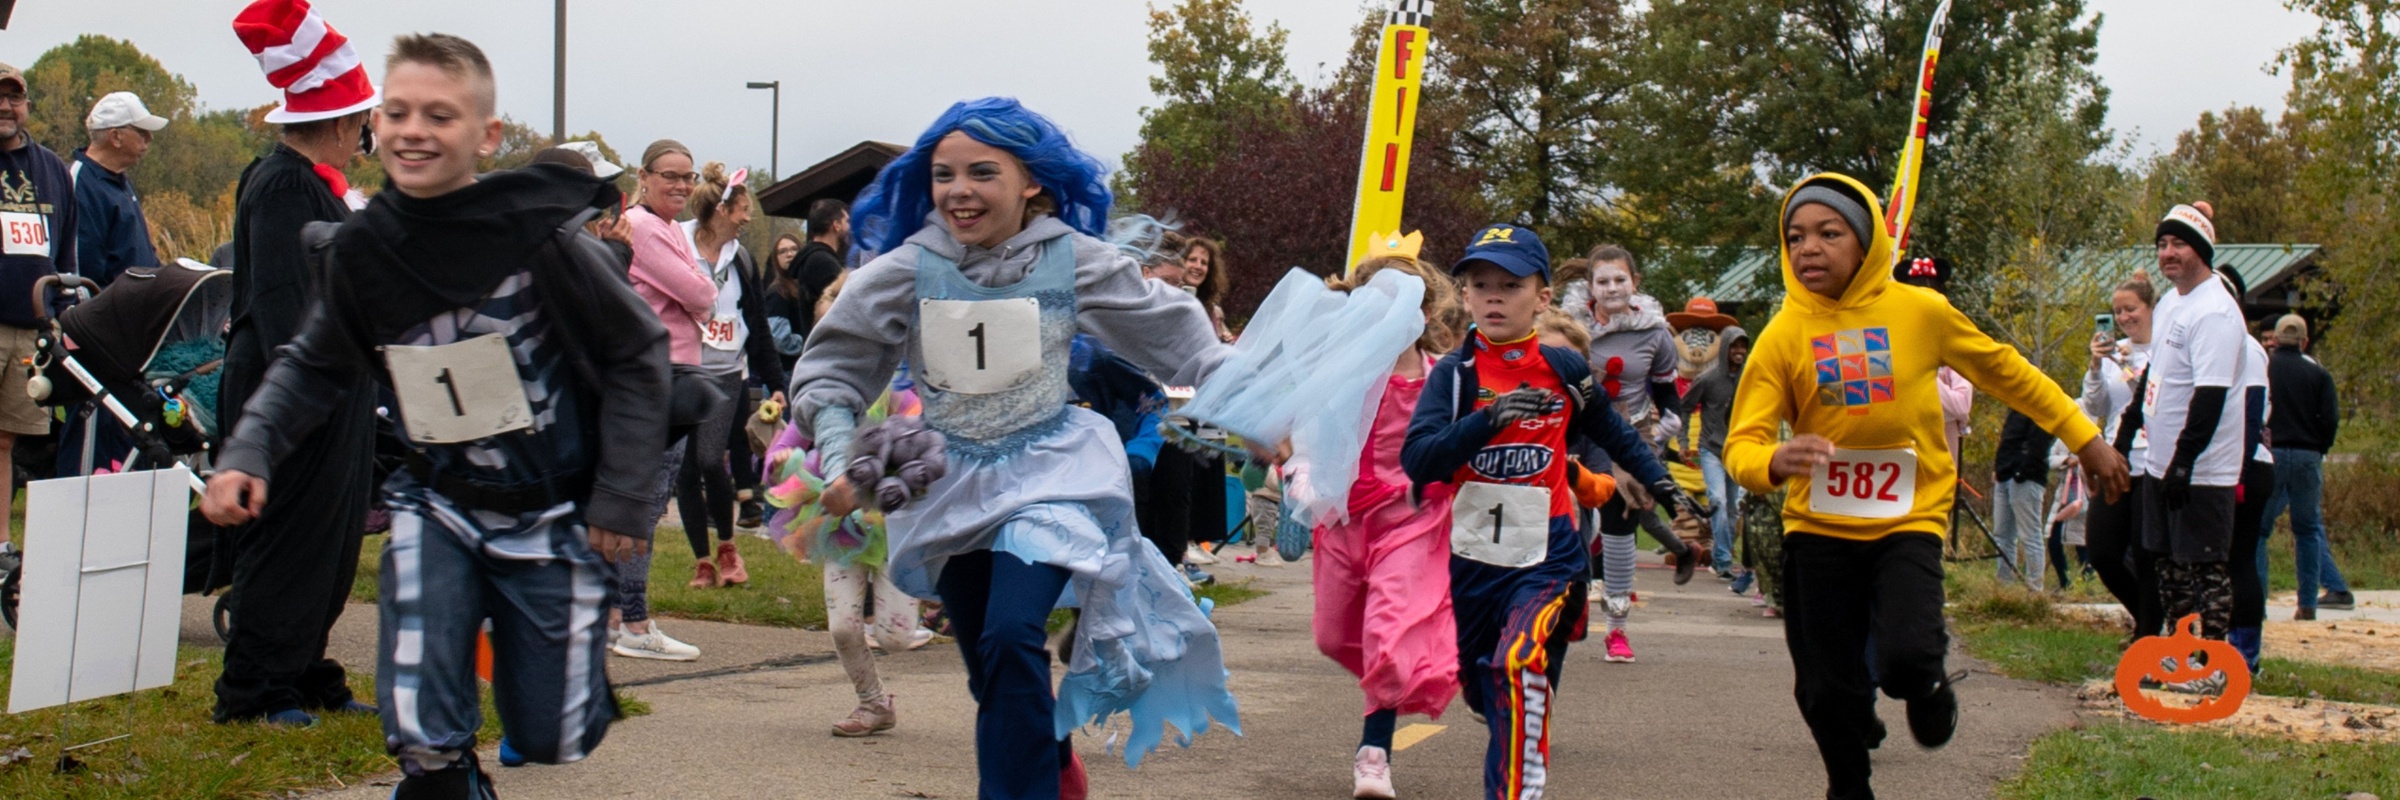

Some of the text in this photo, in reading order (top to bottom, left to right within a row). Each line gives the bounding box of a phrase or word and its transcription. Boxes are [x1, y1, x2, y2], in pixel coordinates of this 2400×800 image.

[10, 221, 44, 246] 530
[1482, 227, 1514, 240] 24
[968, 322, 986, 370] 1
[435, 367, 466, 417] 1
[1826, 461, 1901, 502] 582
[1488, 503, 1503, 545] 1
